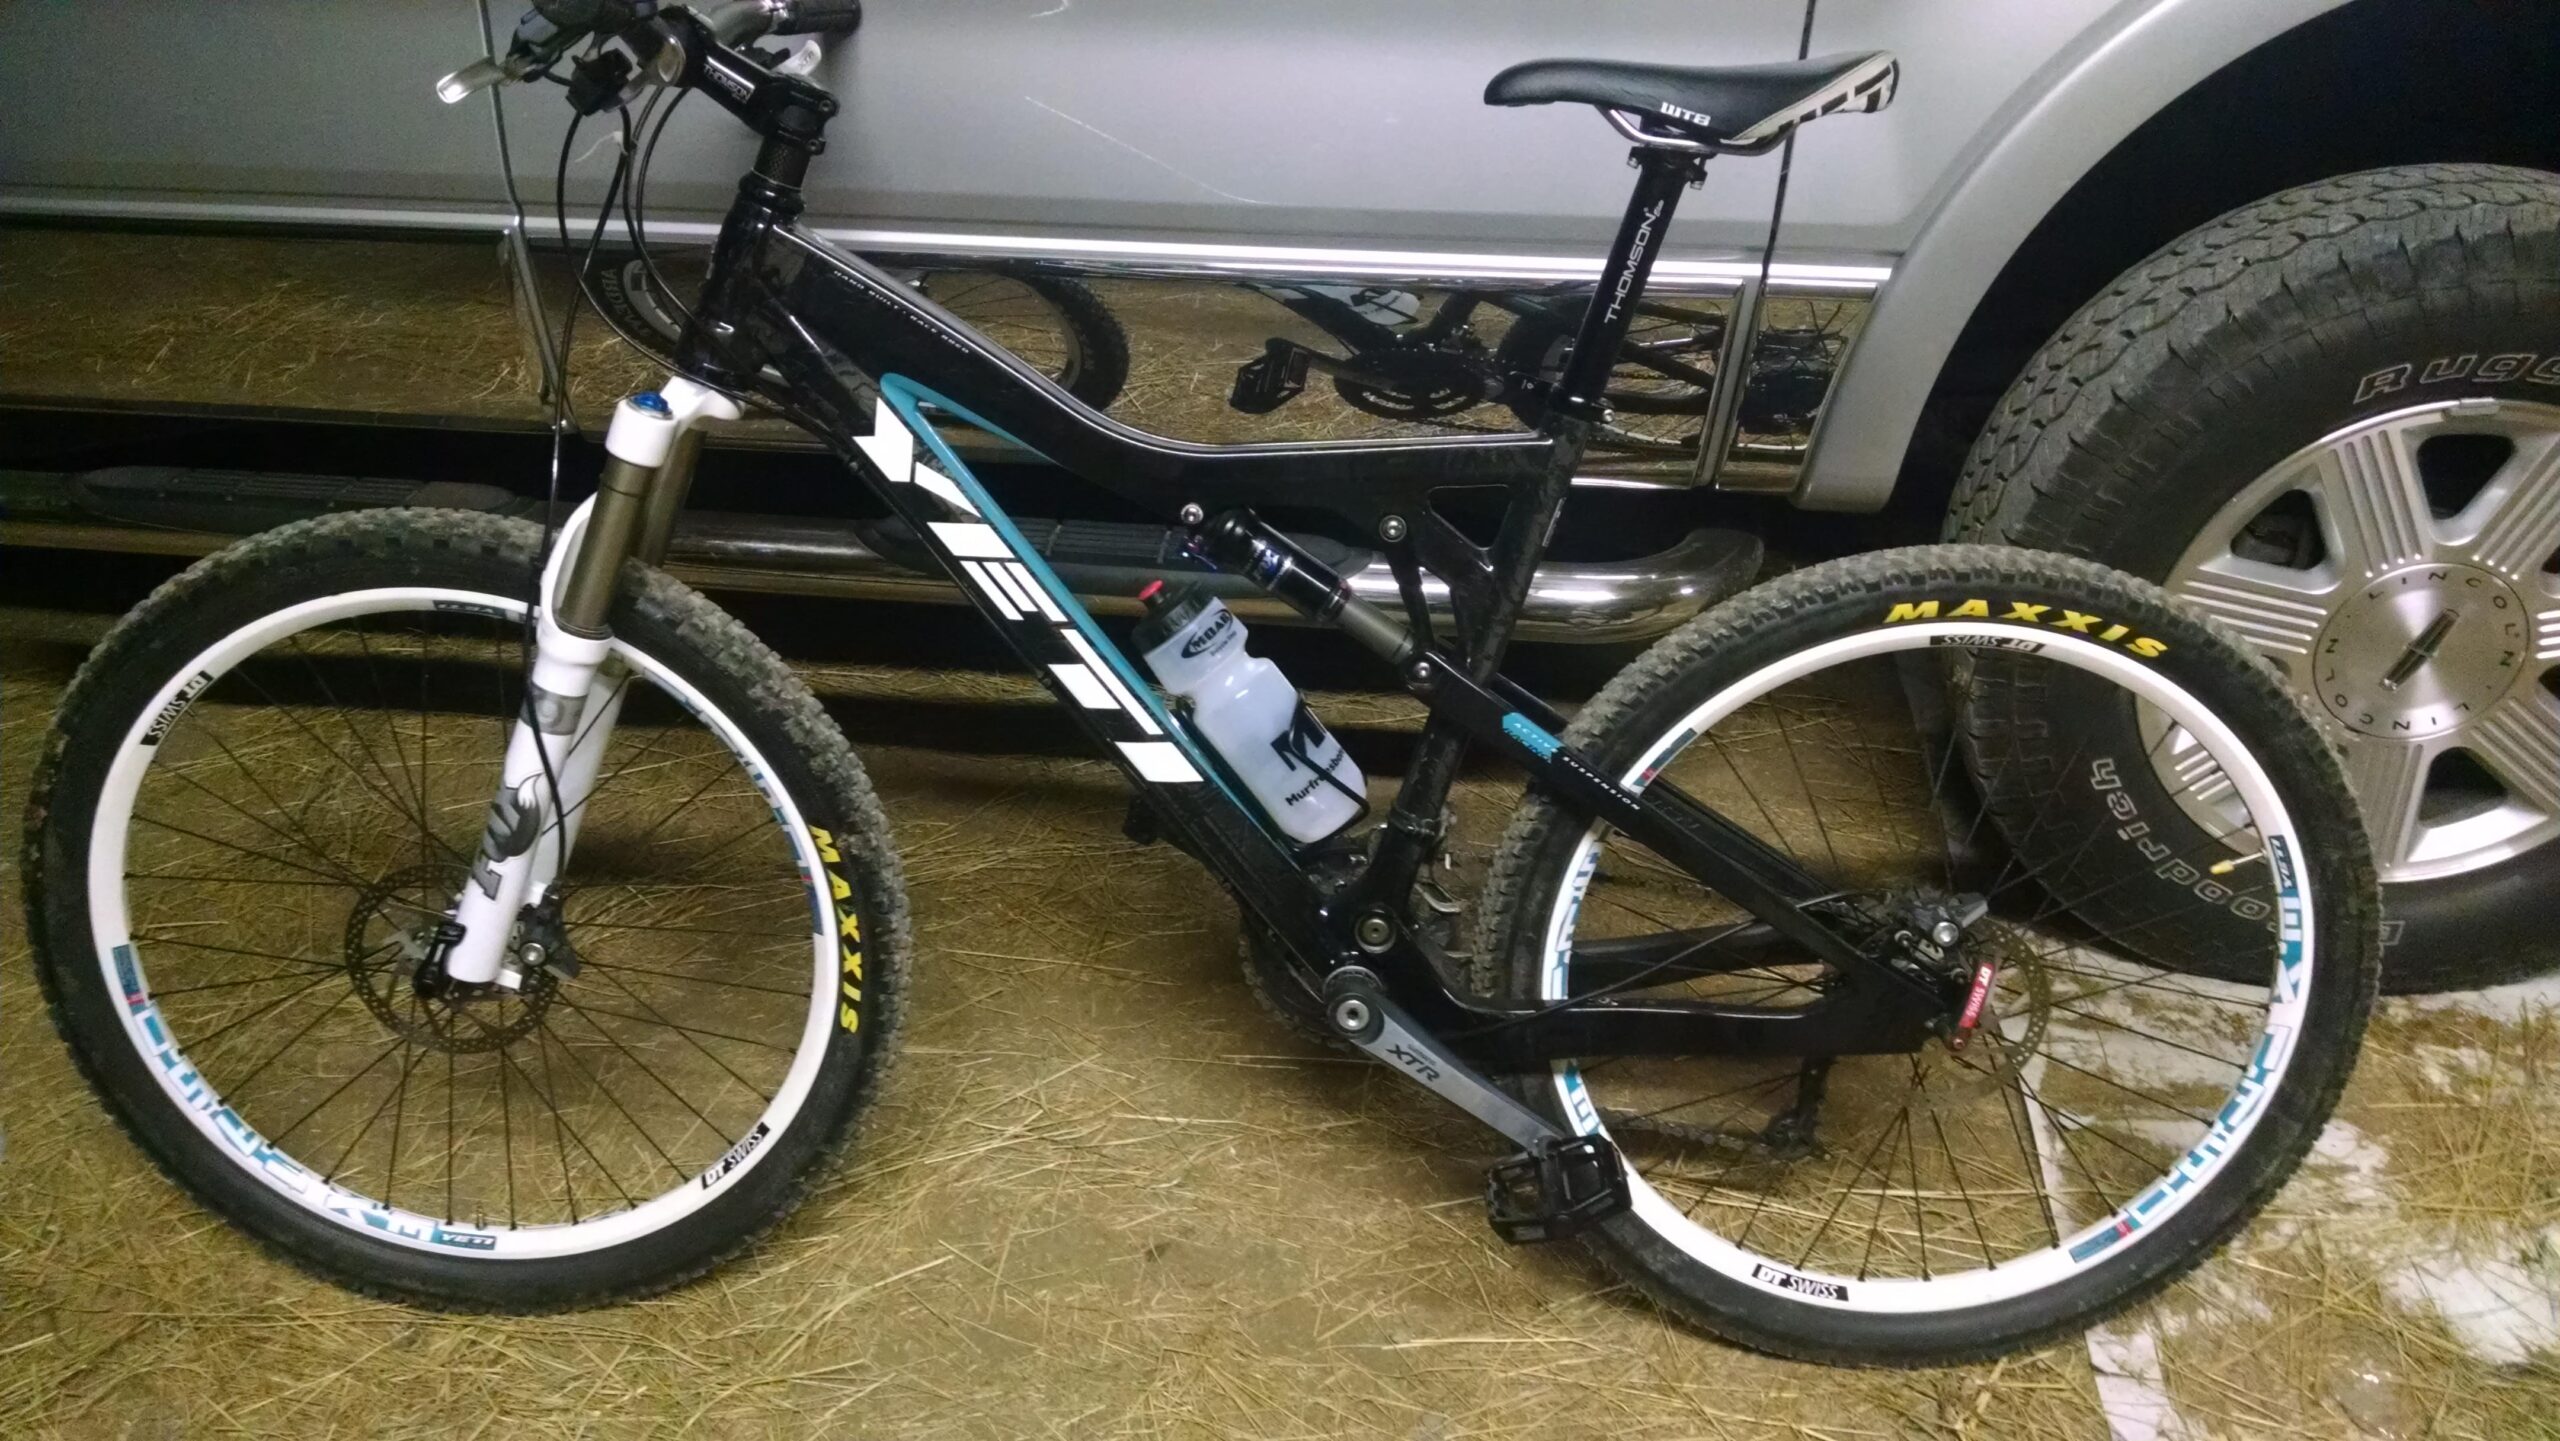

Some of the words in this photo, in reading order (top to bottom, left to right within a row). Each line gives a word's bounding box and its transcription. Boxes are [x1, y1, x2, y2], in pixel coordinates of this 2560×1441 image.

[1660, 102, 1711, 126] WTB
[1604, 212, 1657, 324] THOMSON
[1883, 599, 2168, 658] MAXXIS
[1941, 634, 1999, 648] SWISS
[147, 698, 188, 738] SWISS
[1563, 756, 1640, 810] SUSPENSION
[2090, 758, 2276, 933] oodrich
[809, 824, 862, 1034] MAXXIS
[1385, 1044, 1440, 1082] XTR
[1757, 1266, 1788, 1286] DT
[1787, 1276, 1839, 1300] SWISS
